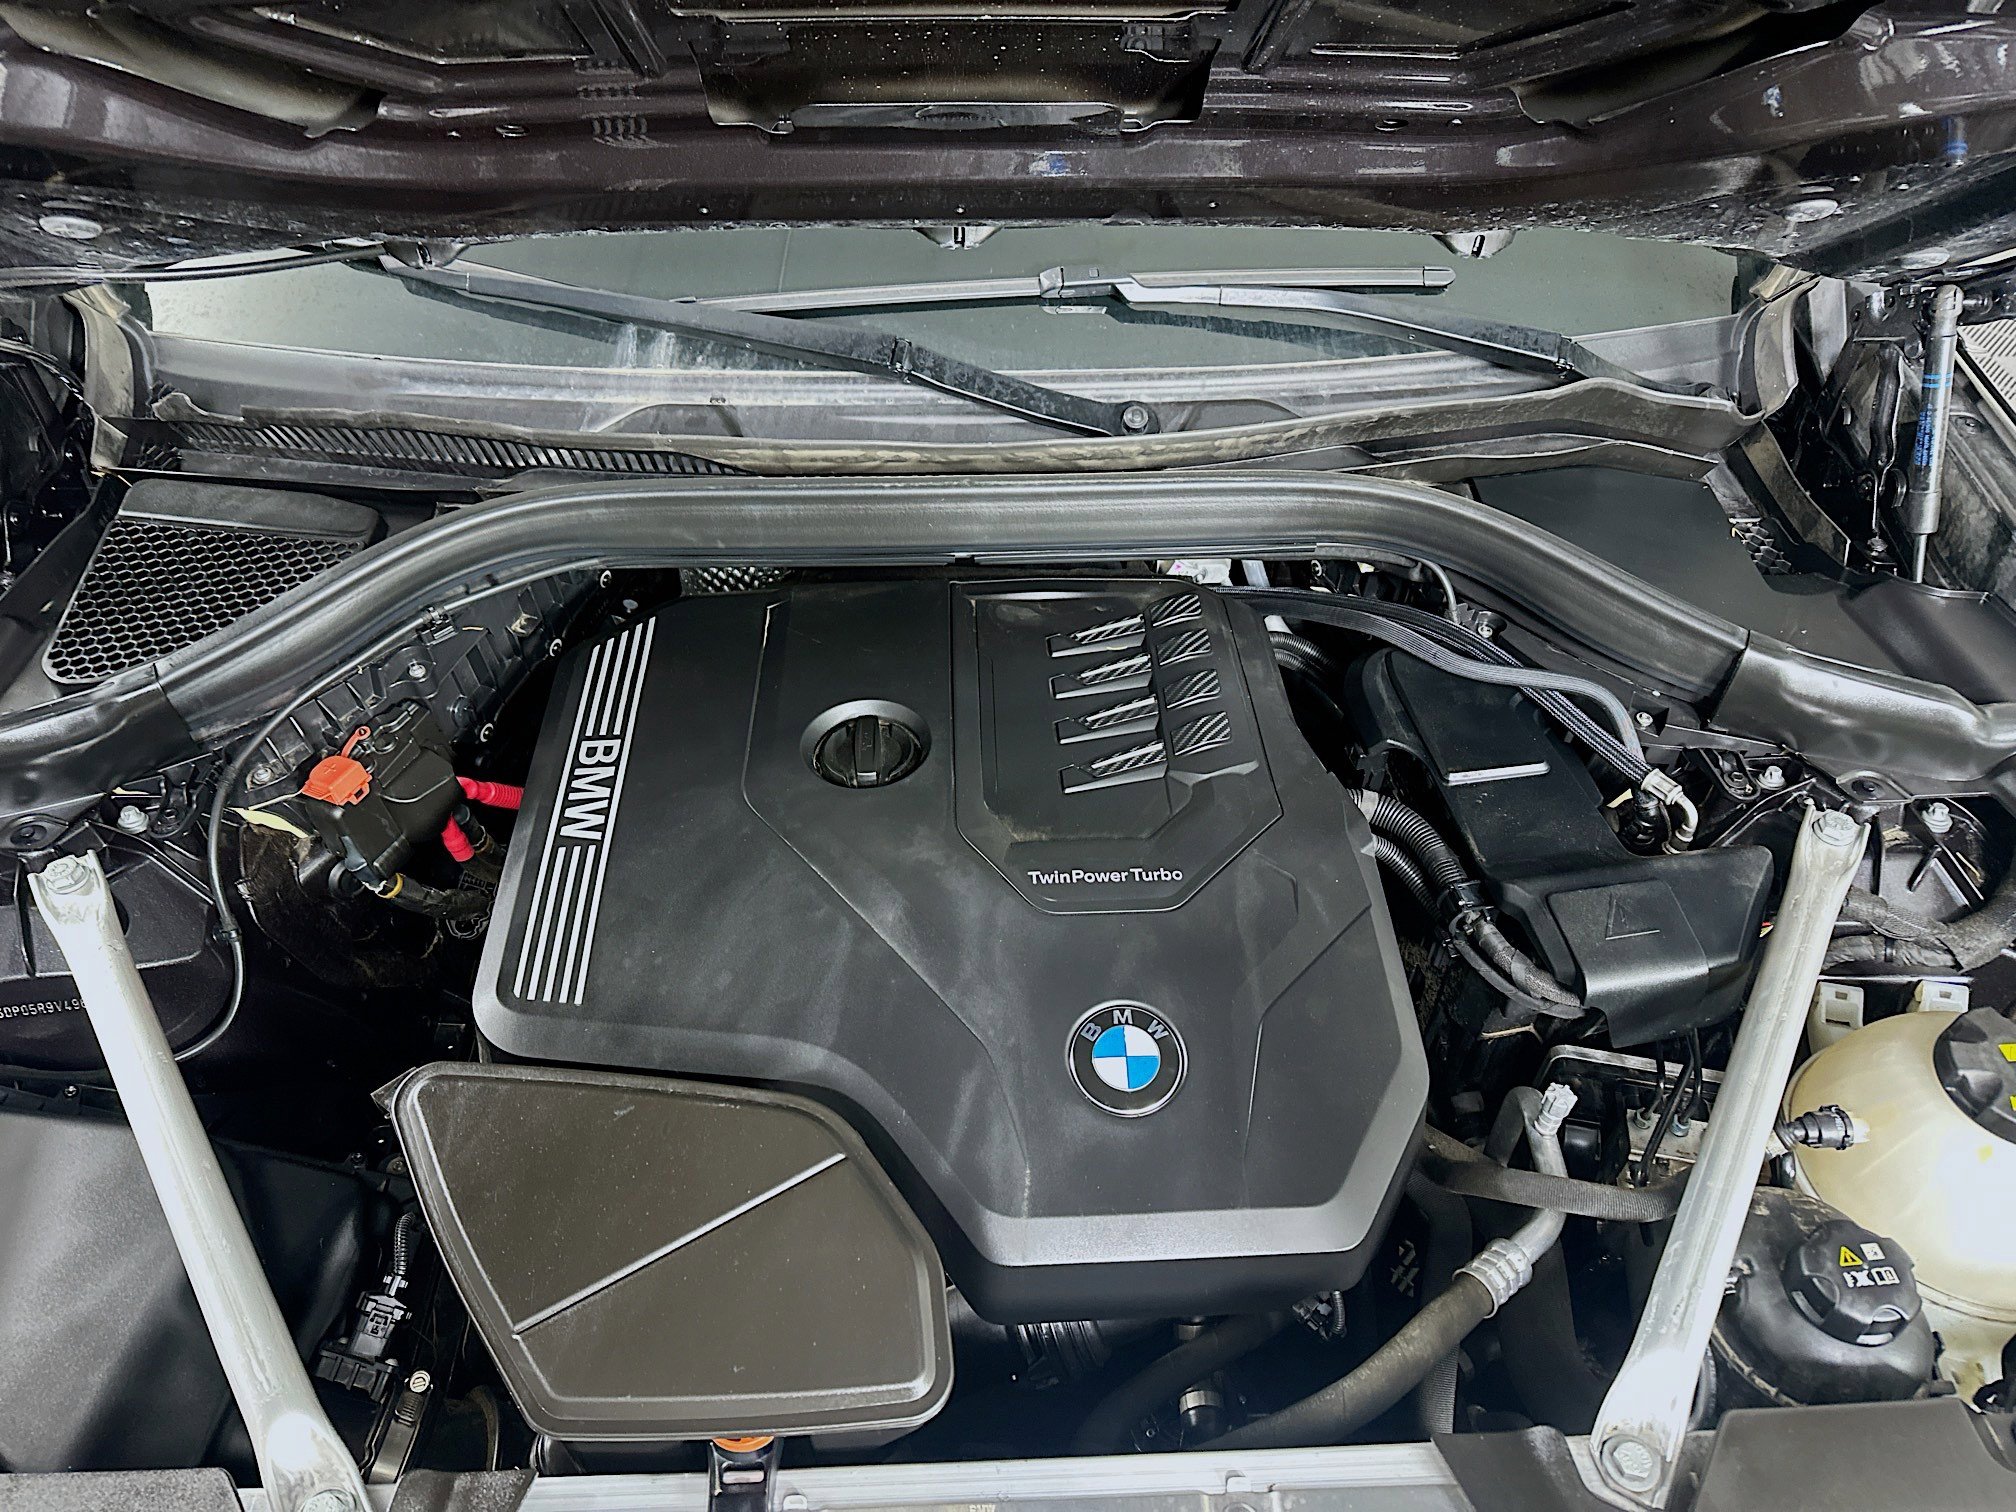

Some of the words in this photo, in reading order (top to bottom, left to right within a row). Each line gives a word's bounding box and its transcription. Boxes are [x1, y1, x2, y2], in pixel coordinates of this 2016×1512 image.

[560, 739, 621, 841] BMW
[1027, 869, 1129, 885] TwinPower
[1129, 867, 1184, 882] Turbo
[1080, 1008, 1170, 1042] BMW
